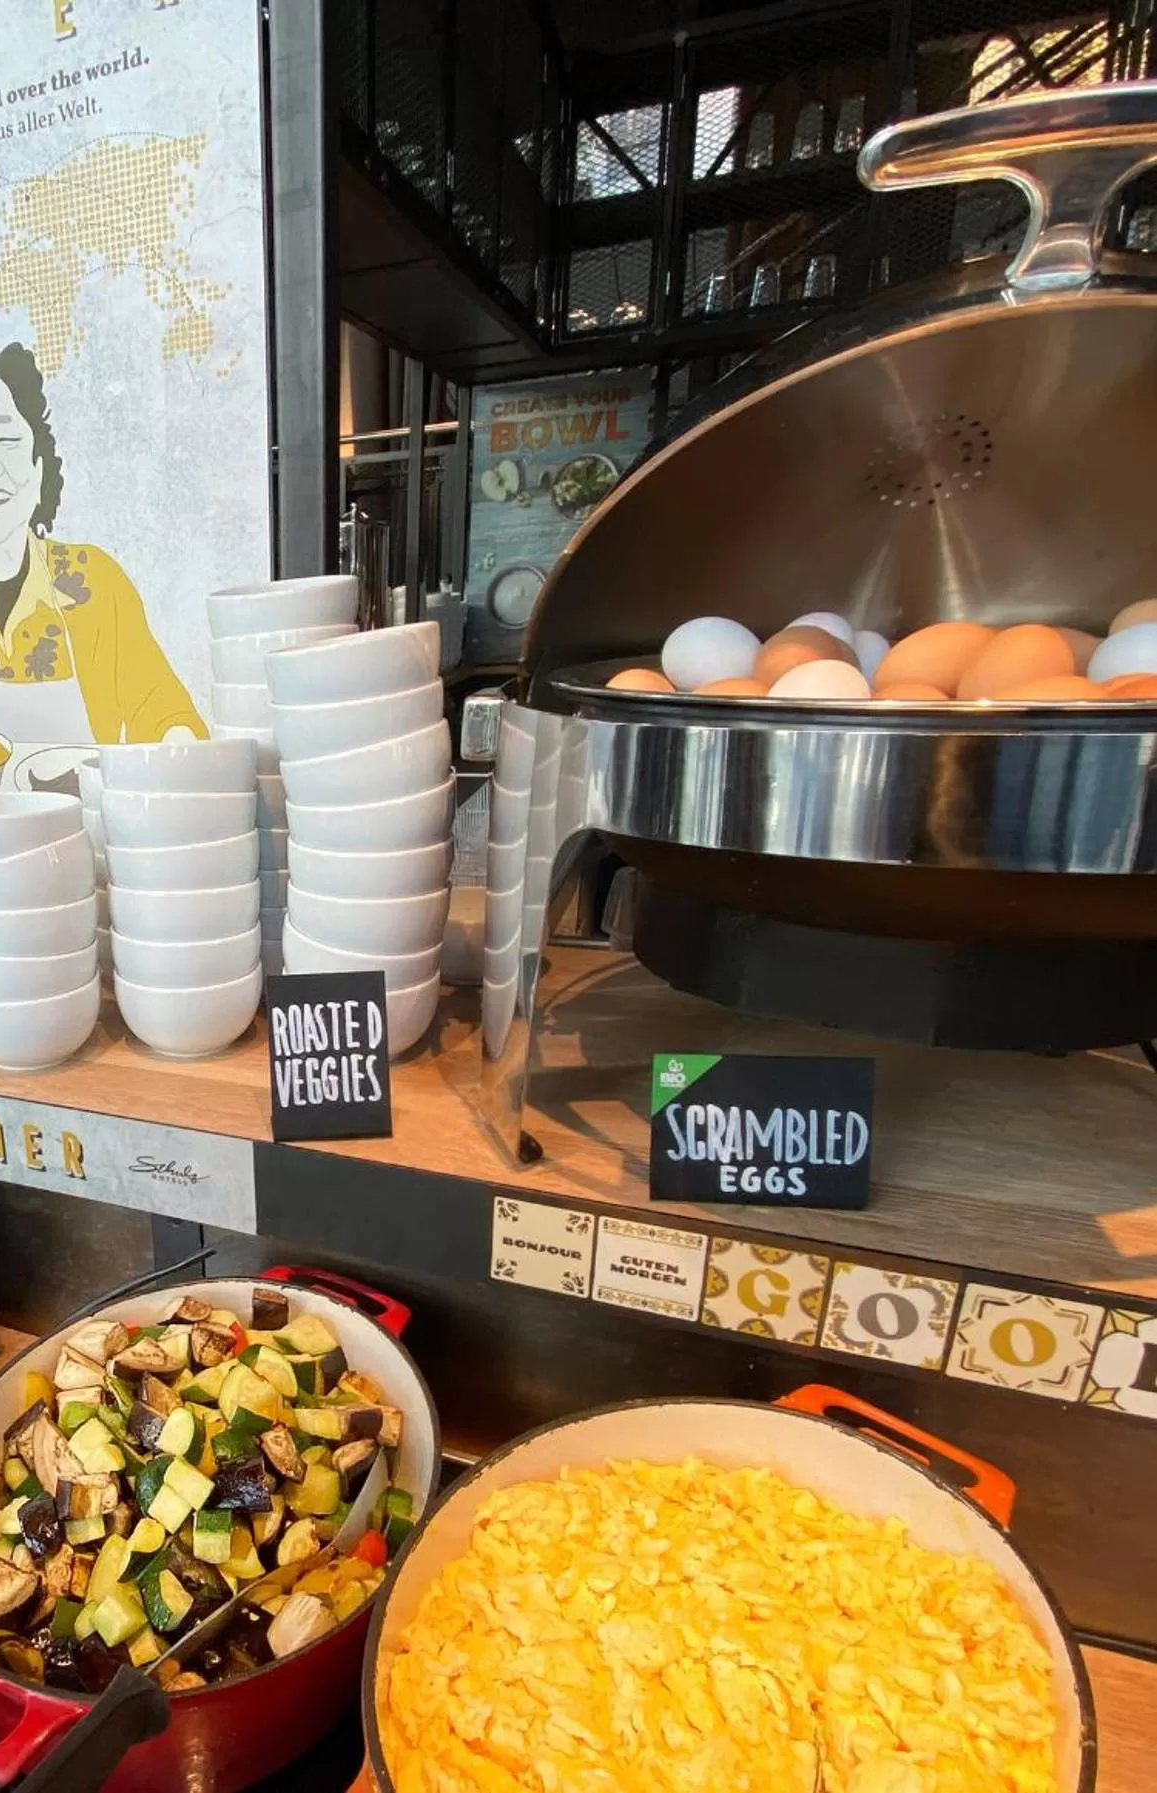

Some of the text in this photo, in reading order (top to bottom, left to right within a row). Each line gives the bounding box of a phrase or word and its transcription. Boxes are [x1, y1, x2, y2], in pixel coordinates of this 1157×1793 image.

[6, 80, 48, 105] over
[51, 69, 82, 92] the
[85, 46, 150, 81] world.
[18, 110, 55, 135] aller
[58, 97, 103, 123] Welt.
[490, 409, 631, 454] BOWL
[271, 1000, 383, 1057] ROASTED
[274, 1053, 383, 1108] VEGGIES
[665, 1103, 870, 1166] SCRAMBLED
[719, 1164, 807, 1196] EGGS
[502, 1236, 582, 1261] BONJOUR
[619, 1255, 679, 1275] GUTEN
[610, 1263, 688, 1287] MORGEN
